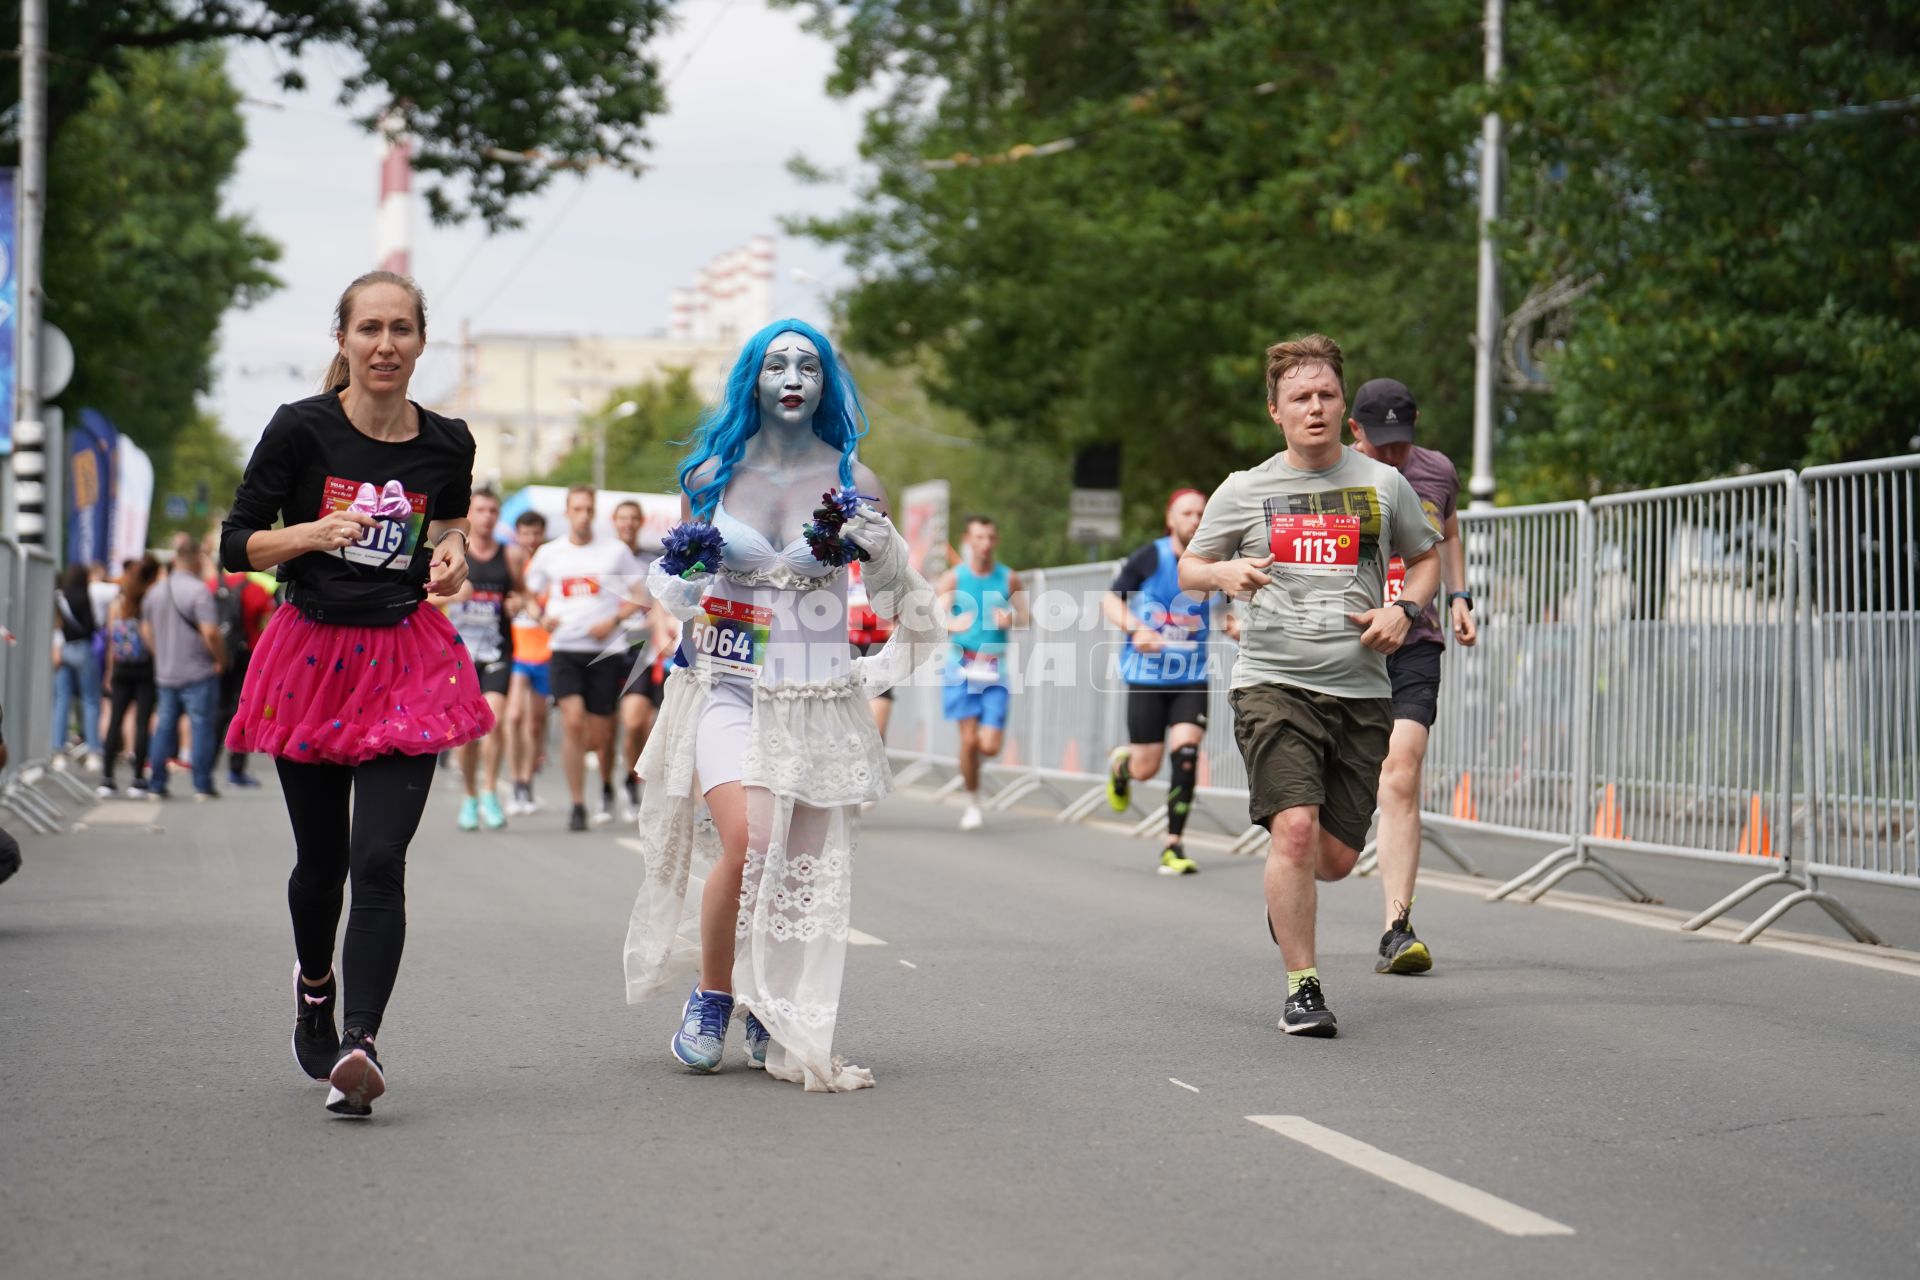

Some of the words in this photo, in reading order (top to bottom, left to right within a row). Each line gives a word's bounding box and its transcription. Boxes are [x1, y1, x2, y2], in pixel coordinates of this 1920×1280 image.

[356, 519, 405, 552] 015
[1292, 537, 1337, 563] 1113
[1384, 579, 1405, 602] 13
[692, 622, 750, 660] 5064
